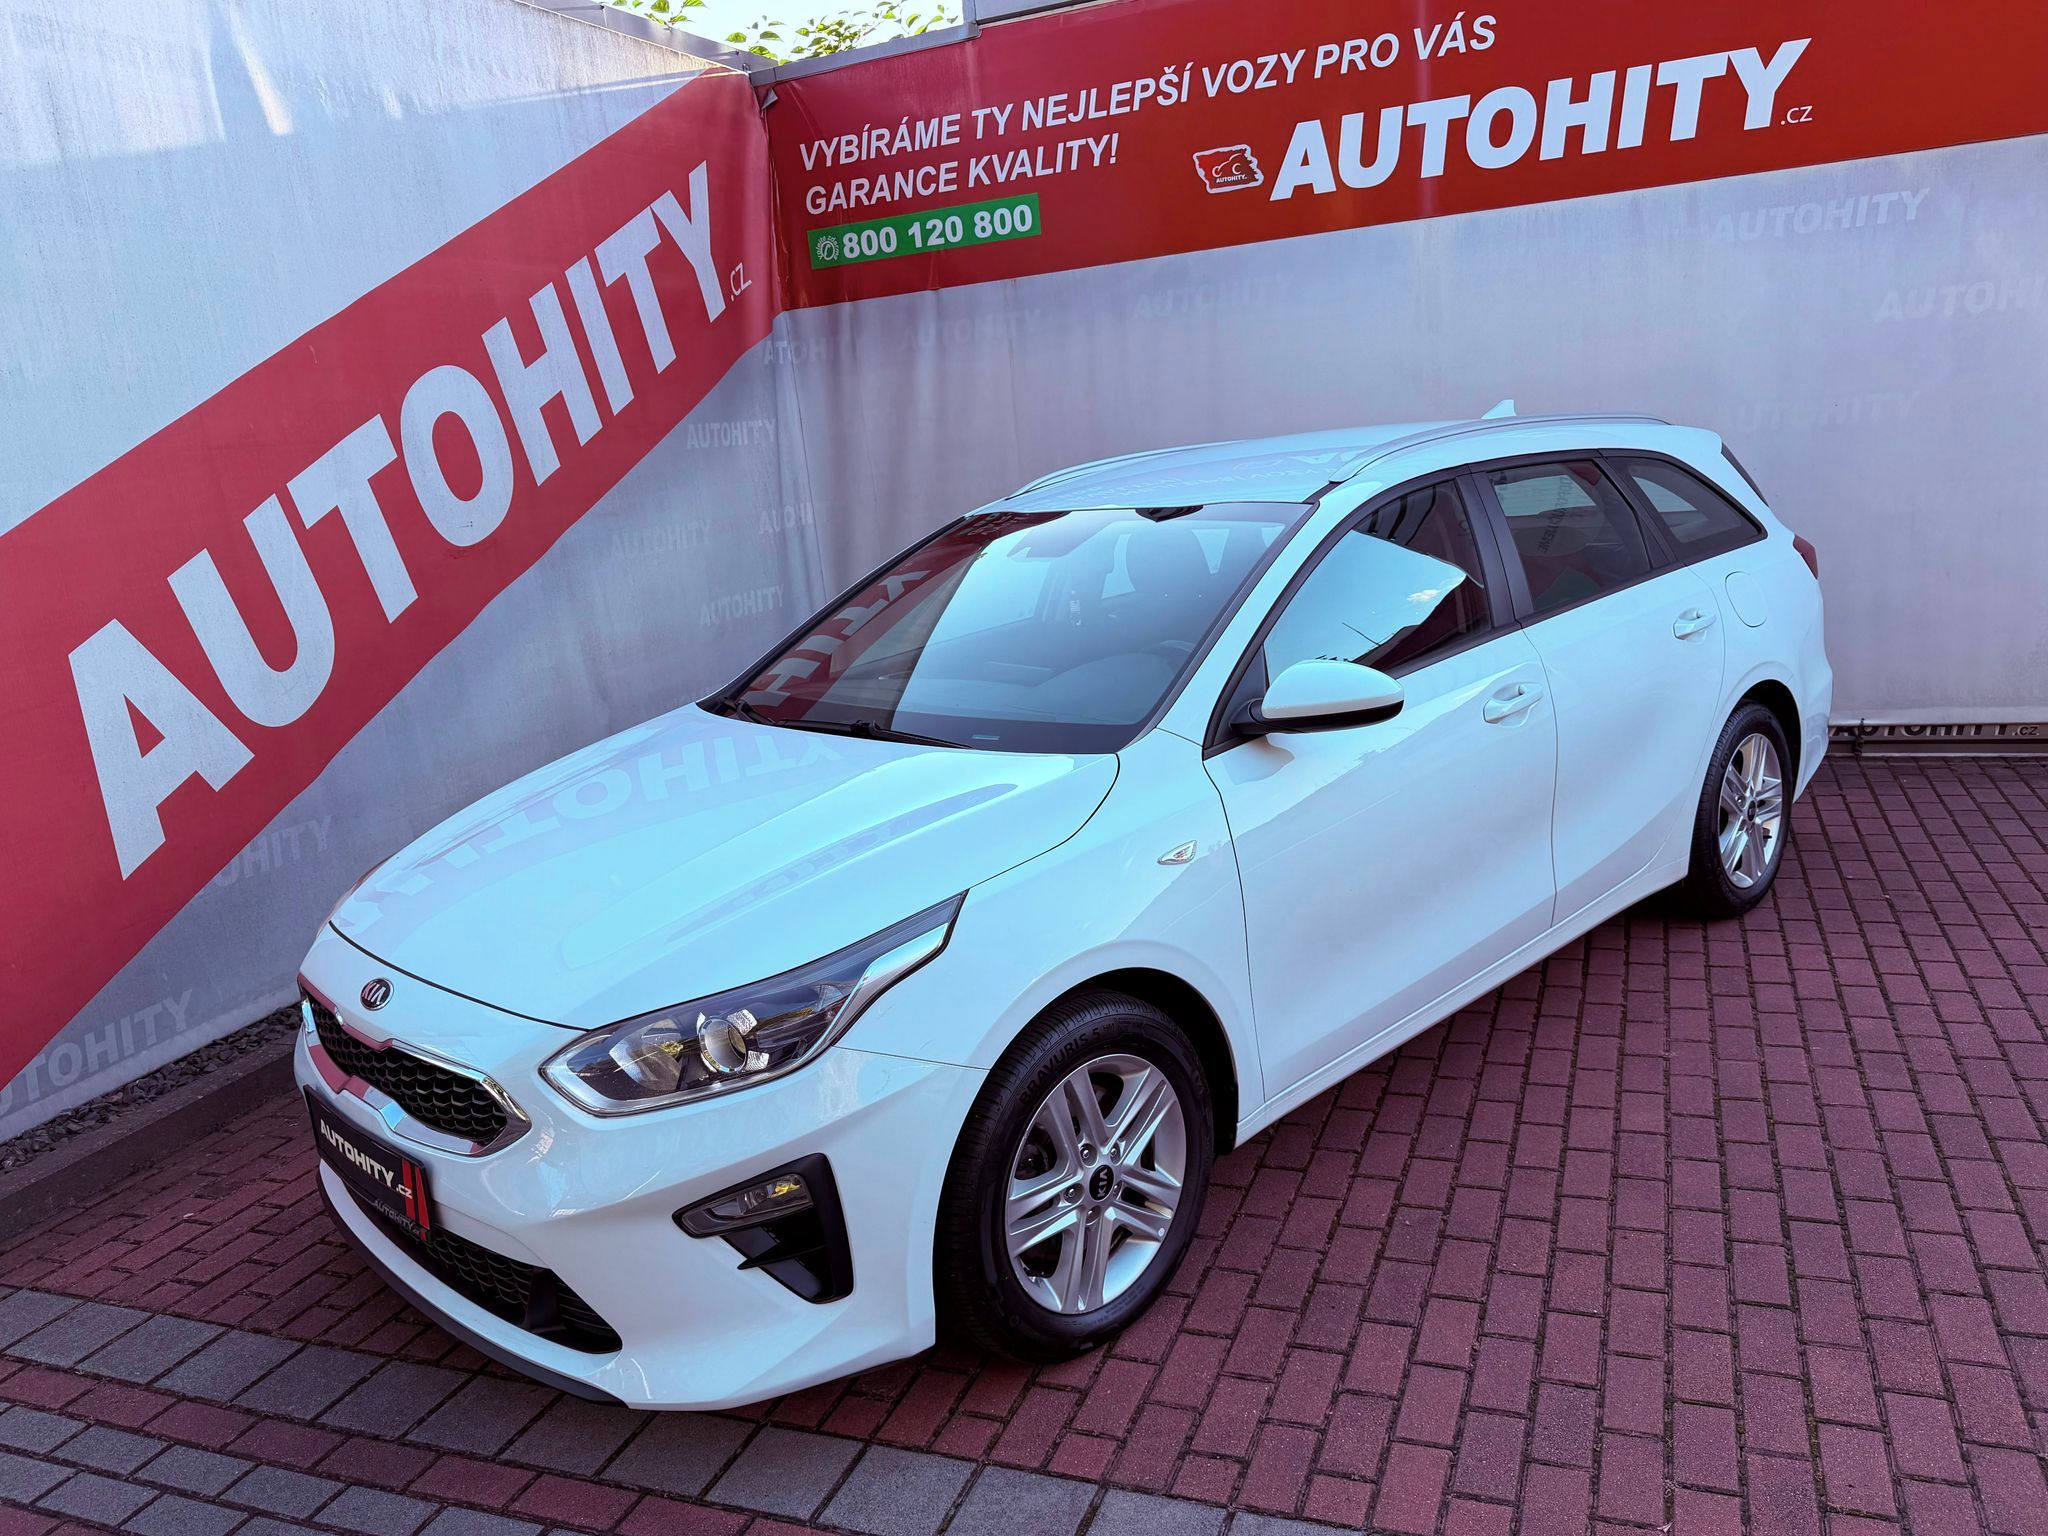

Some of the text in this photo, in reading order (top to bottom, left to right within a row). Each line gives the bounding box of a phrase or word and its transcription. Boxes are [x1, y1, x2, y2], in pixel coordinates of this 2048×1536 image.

[800, 11, 1498, 171] VYBÍRÁME TY NEJLEPŠÍ VOZY PRO VÁS
[1269, 38, 1812, 201] AUTOHITY
[805, 132, 1120, 215] GARANCE KVALITY!
[842, 204, 1033, 259] 800 120 800
[67, 160, 726, 881] AUTOHITY
[1019, 1034, 1088, 1104] BRAVURIS
[1097, 1168, 1108, 1198] KIA
